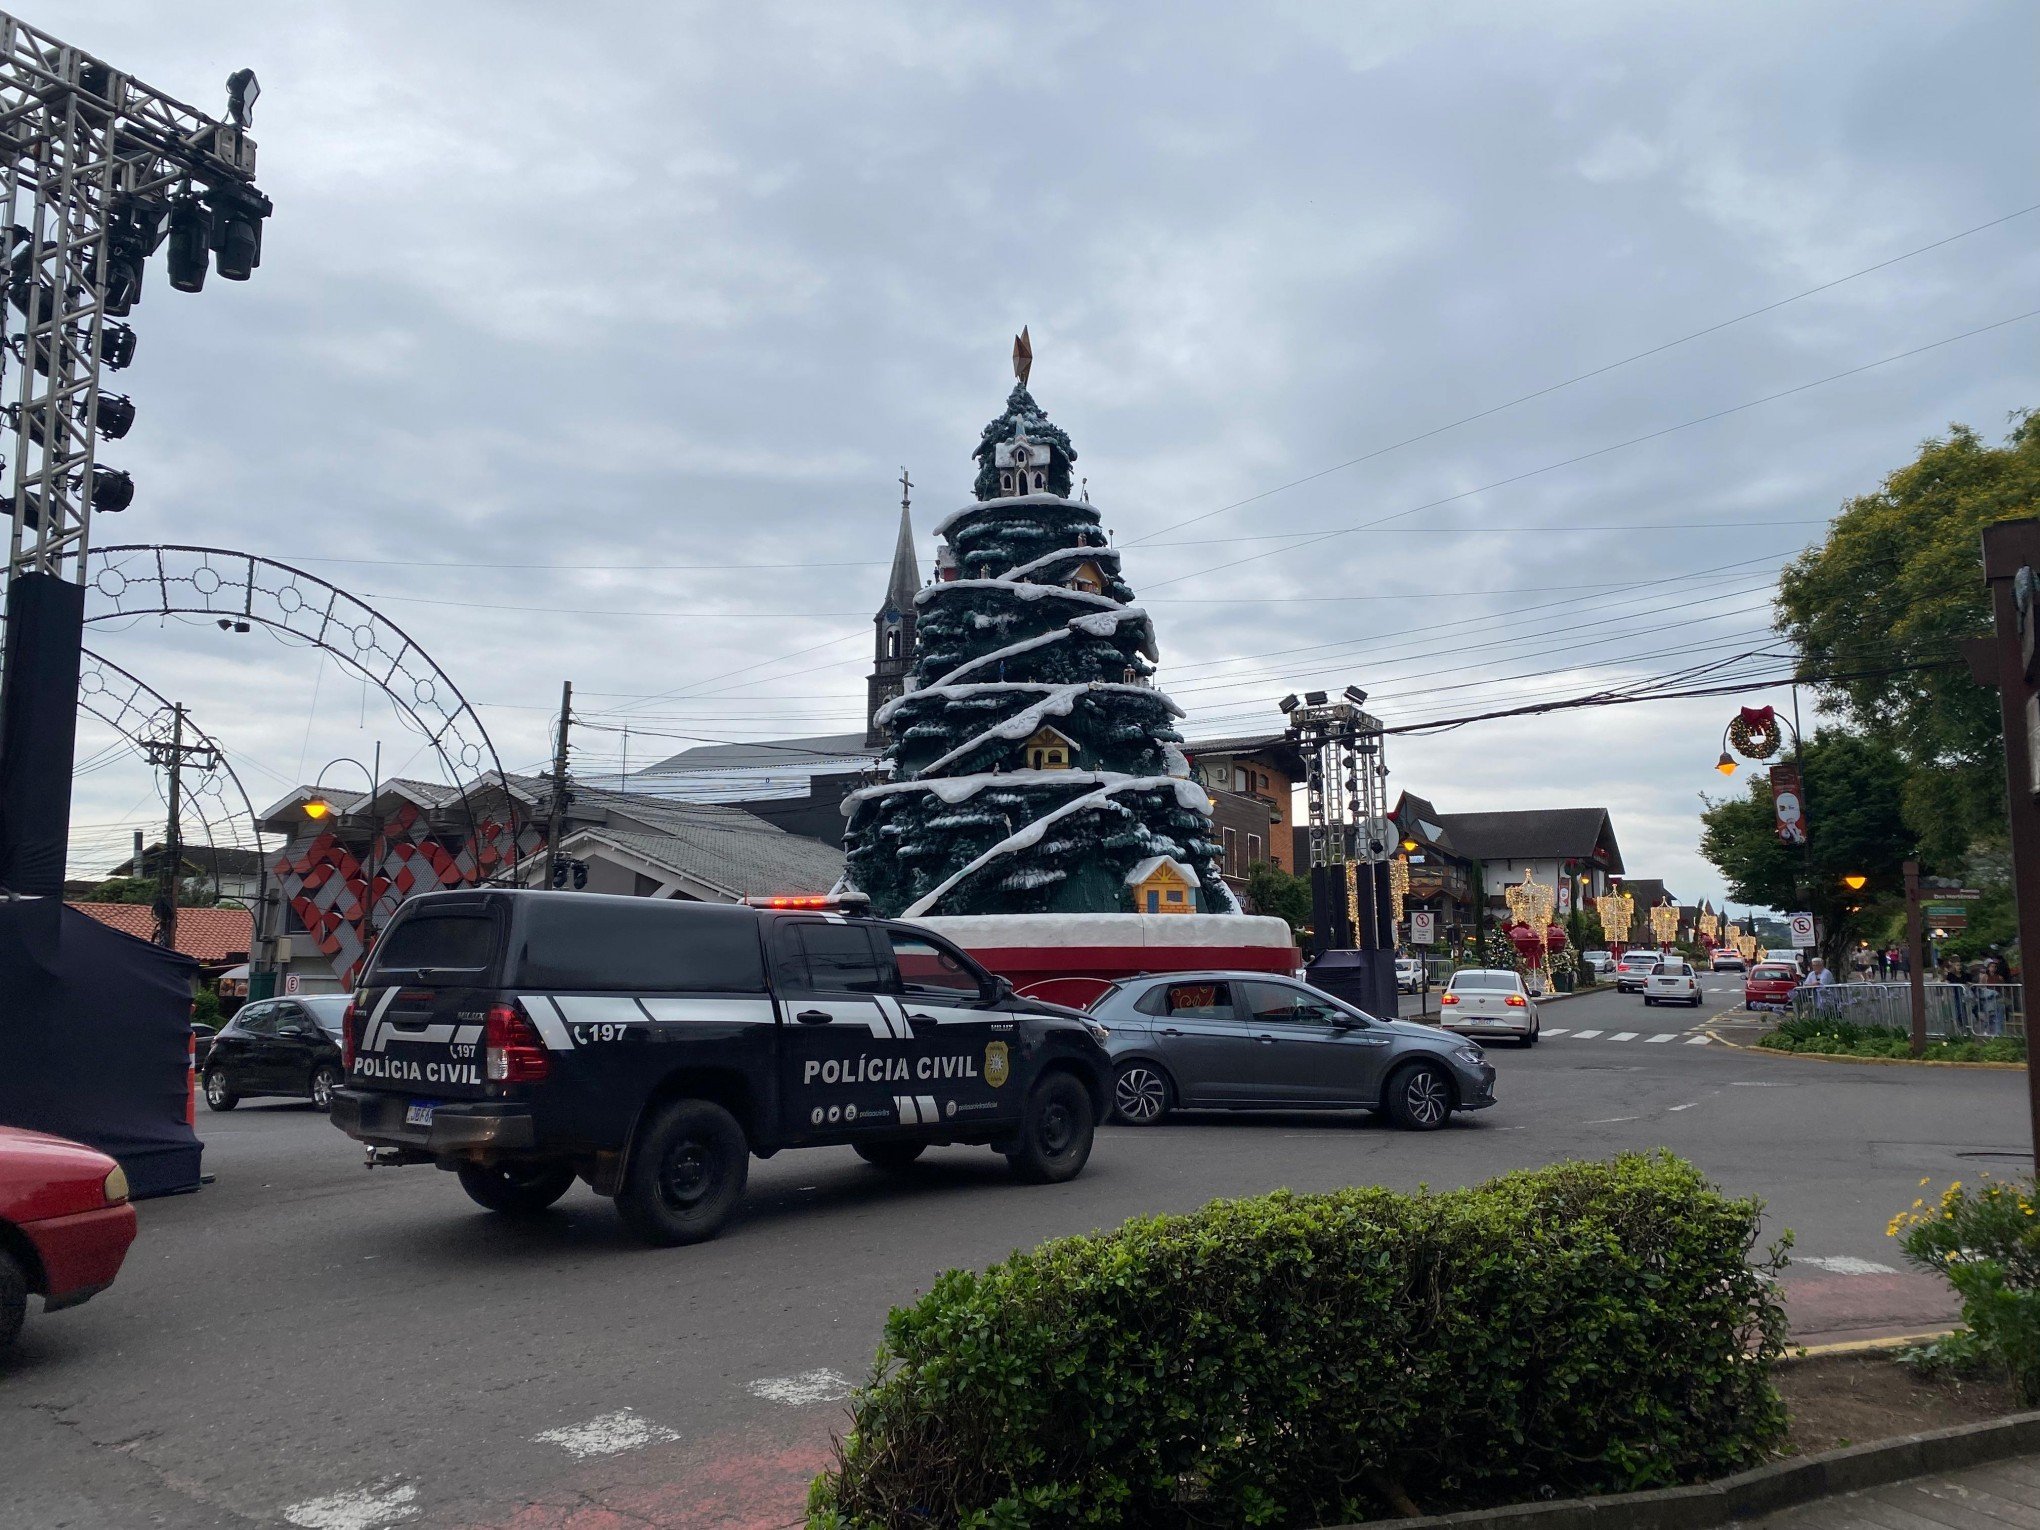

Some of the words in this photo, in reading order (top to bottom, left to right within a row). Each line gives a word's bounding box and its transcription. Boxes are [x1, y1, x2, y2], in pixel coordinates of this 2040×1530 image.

[588, 1024, 627, 1042] 197
[457, 1045, 476, 1058] 197
[353, 1056, 421, 1080] POLÍCIA
[426, 1063, 481, 1085] CIVIL
[804, 1054, 909, 1084] POLÍCIA
[917, 1056, 977, 1080] CIVIL
